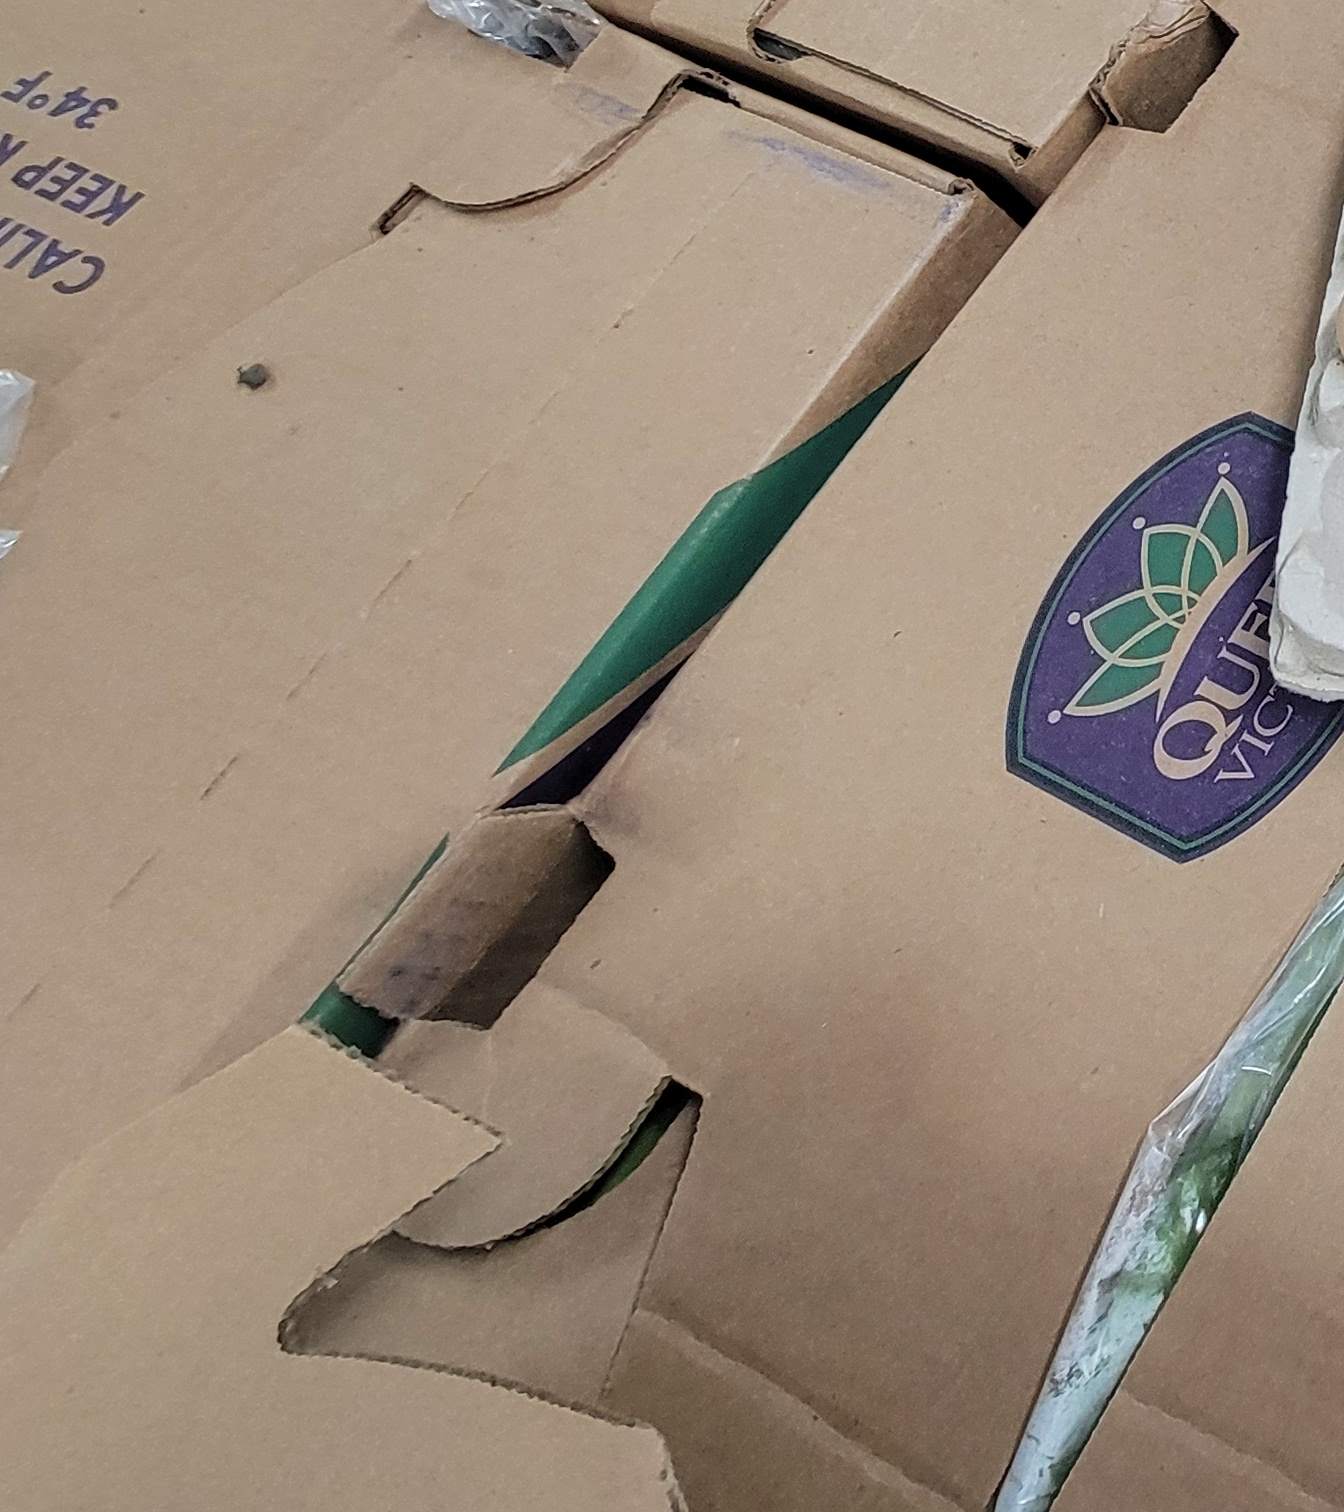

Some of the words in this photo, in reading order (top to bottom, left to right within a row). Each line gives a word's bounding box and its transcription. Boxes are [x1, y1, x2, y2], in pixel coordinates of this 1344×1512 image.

[11, 155, 146, 227] KEEP
[0, 217, 106, 295] CALI
[1152, 571, 1275, 781] QUE
[1213, 687, 1296, 785] VIC
